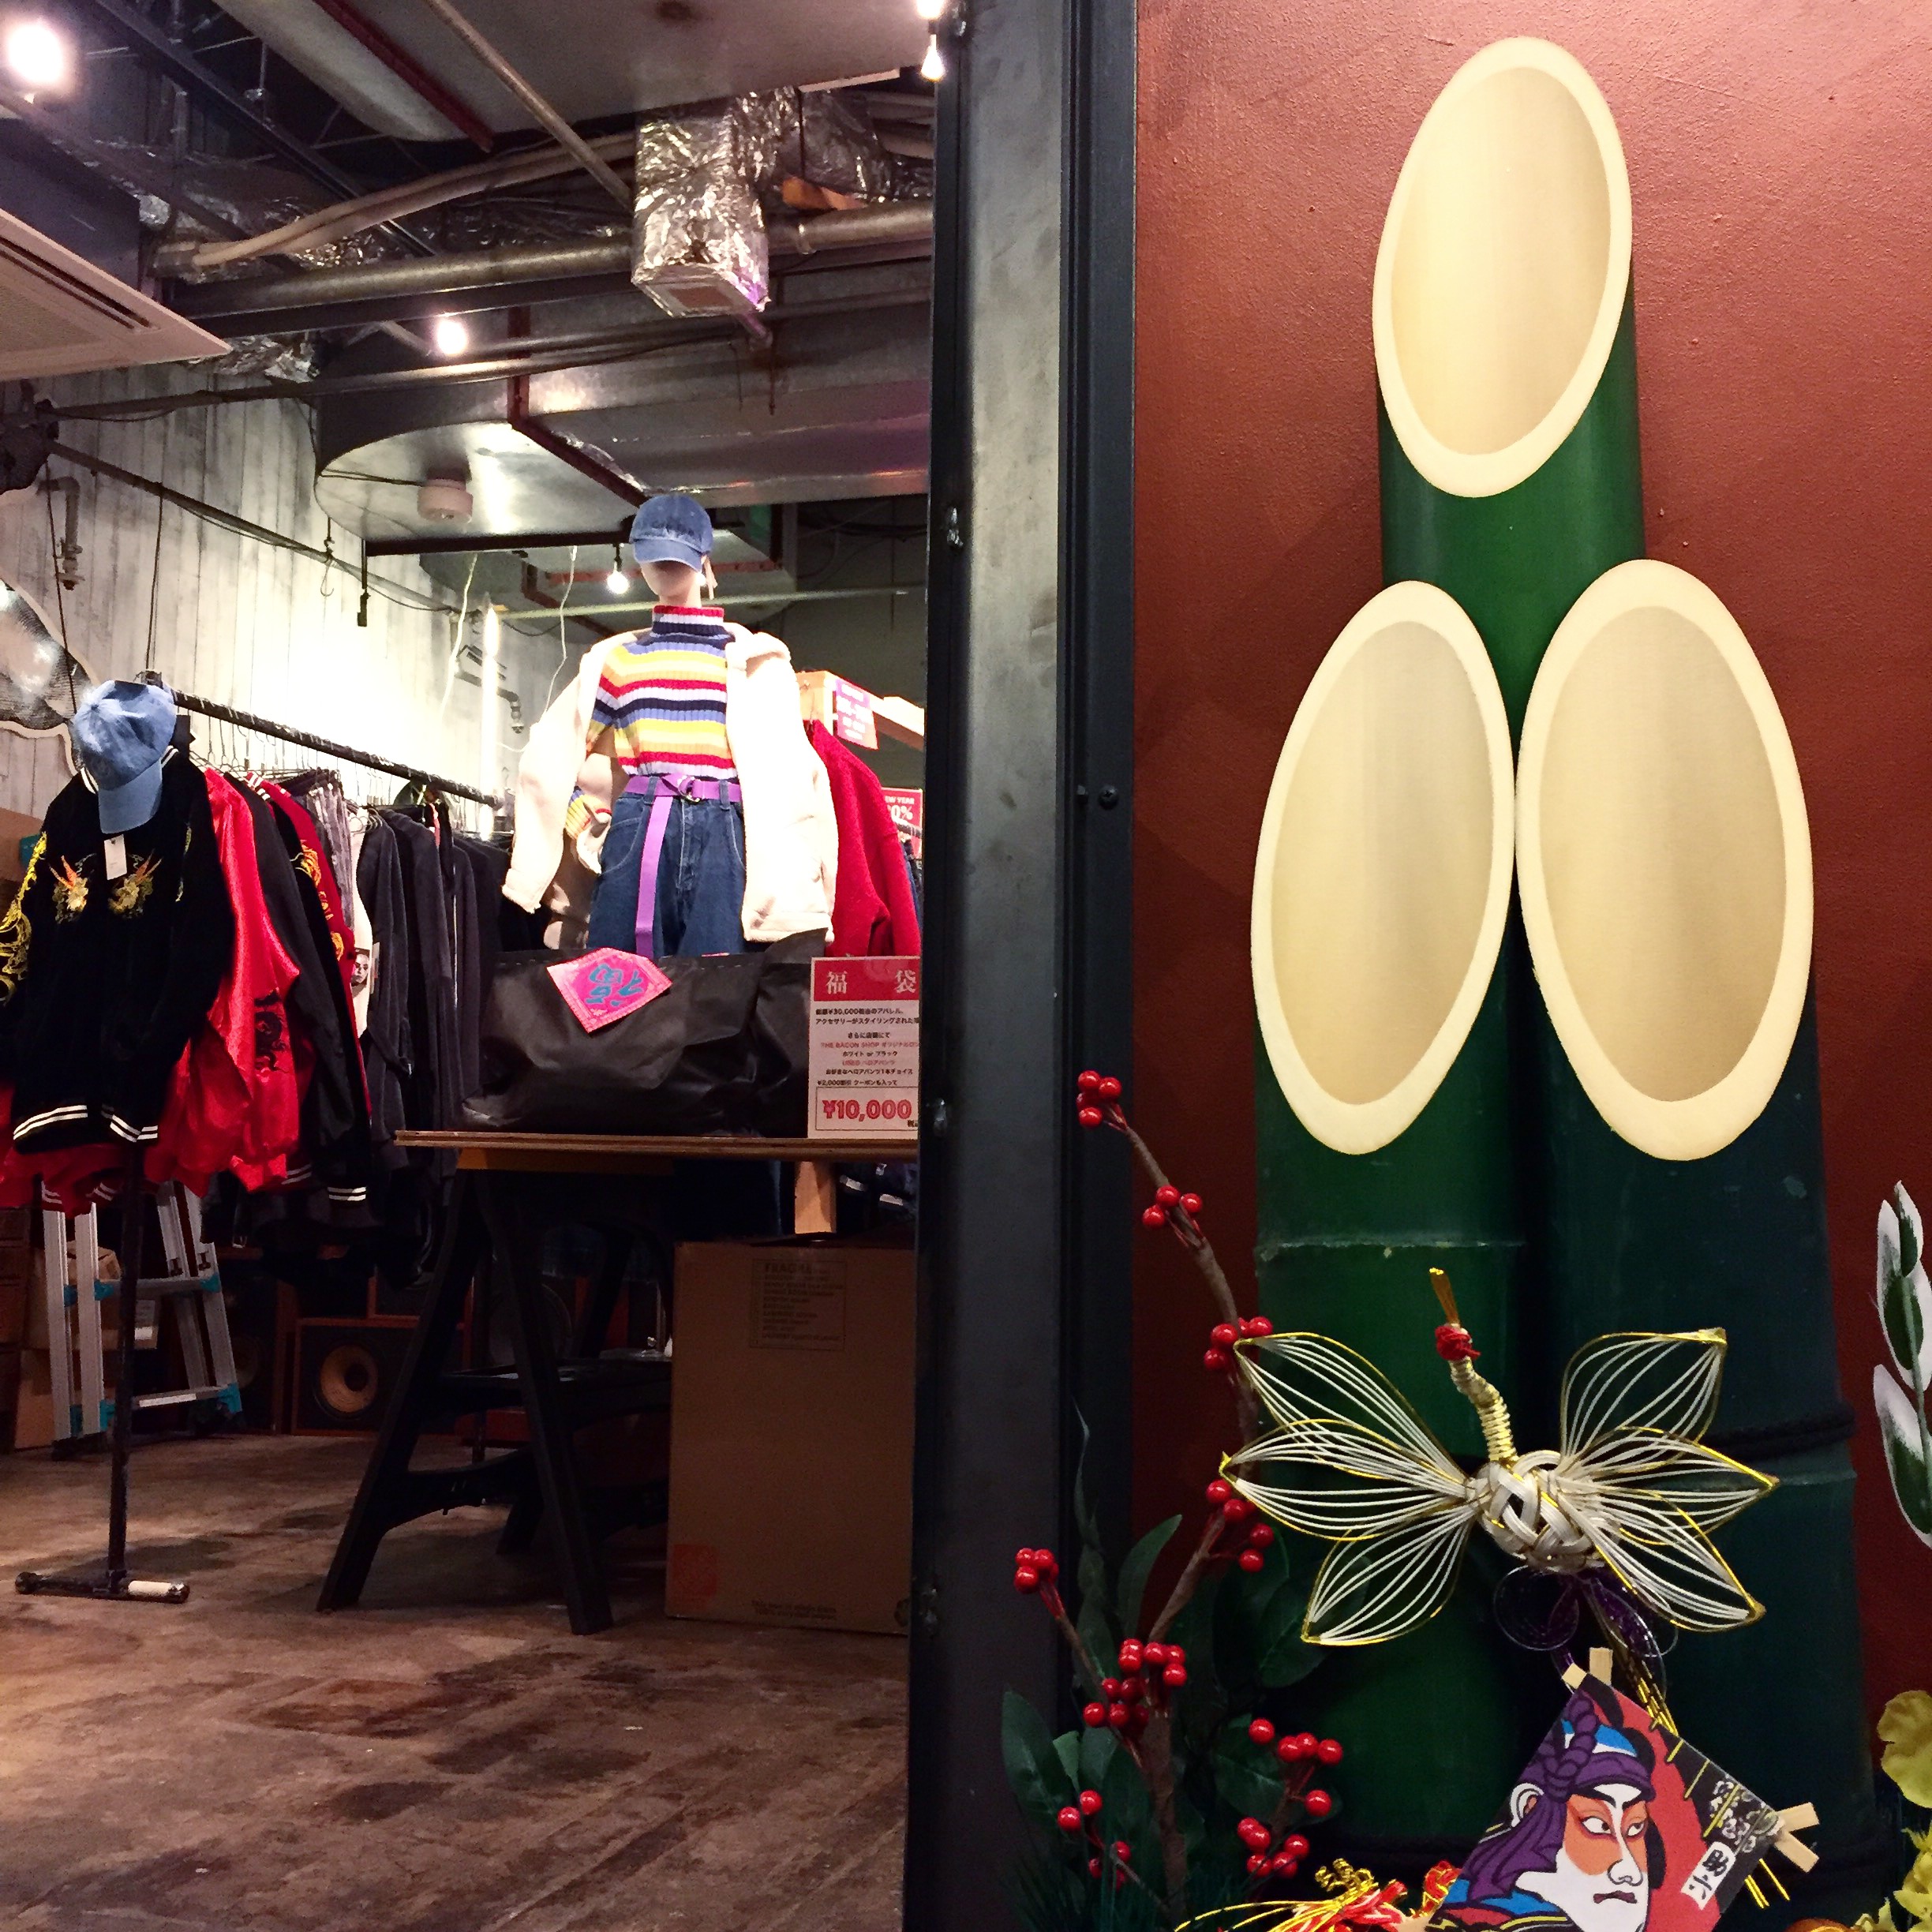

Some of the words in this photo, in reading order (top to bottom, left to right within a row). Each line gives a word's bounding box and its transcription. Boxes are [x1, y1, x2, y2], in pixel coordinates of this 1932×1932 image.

[897, 796, 915, 805] YEAR
[887, 804, 913, 820] 0%
[822, 1099, 912, 1122] ¥10,000
